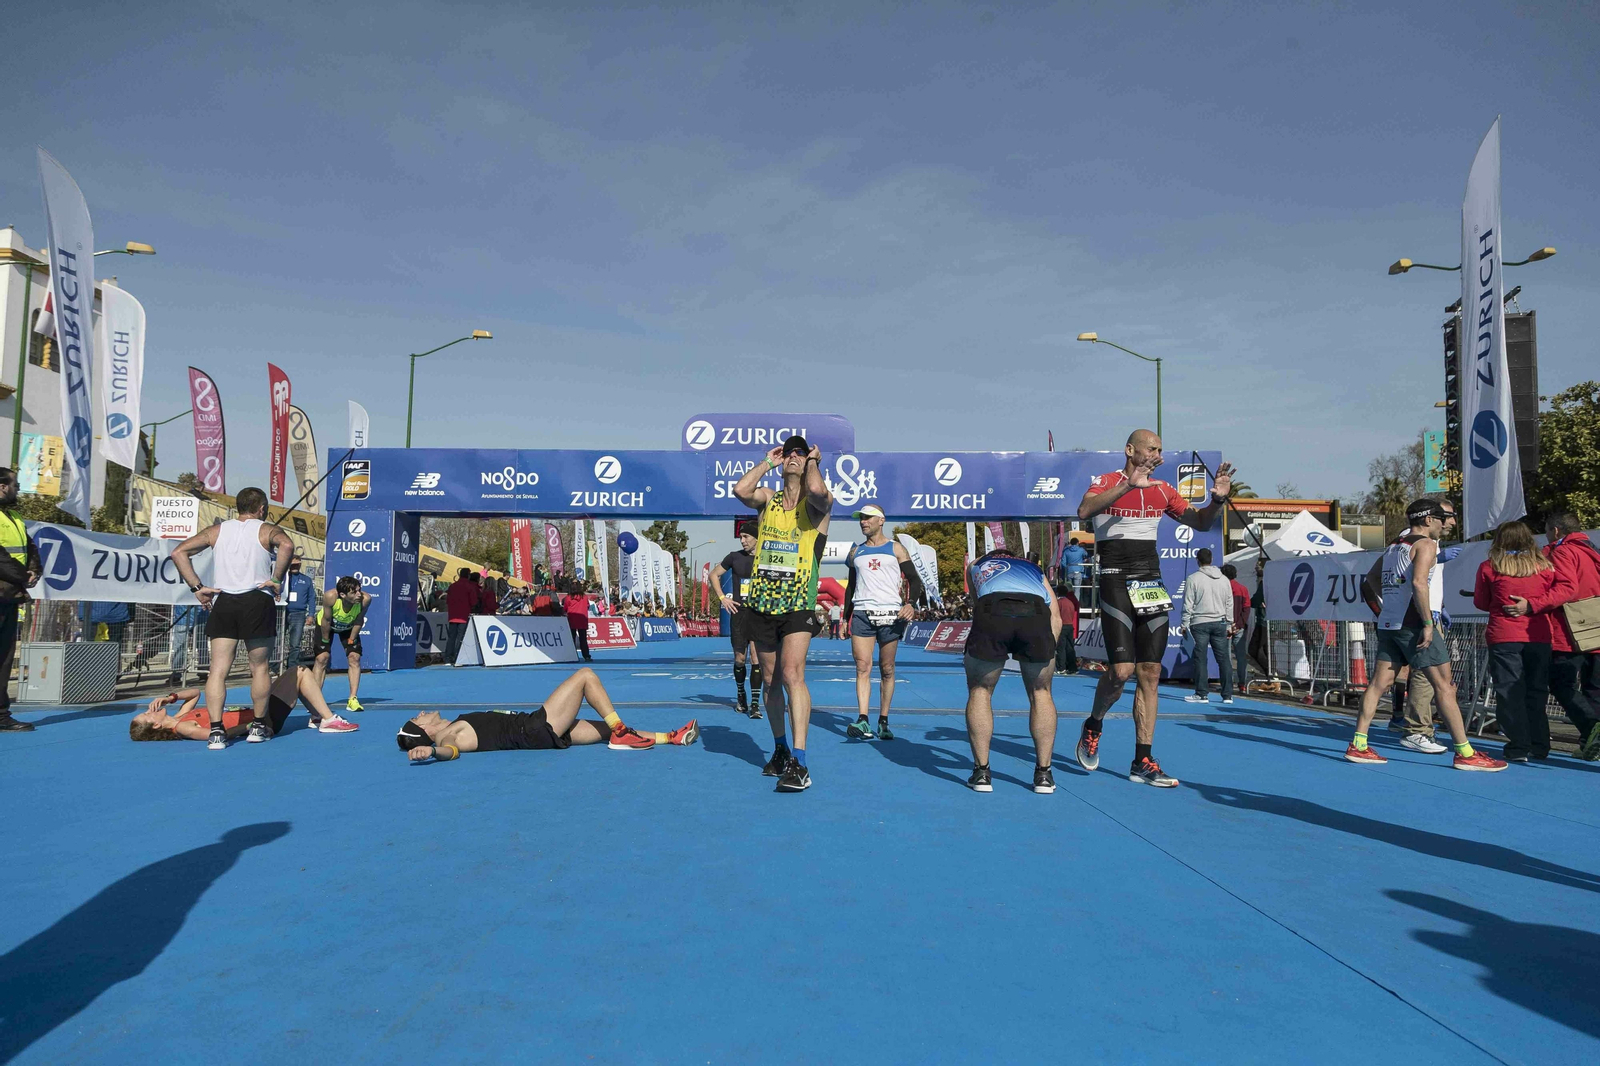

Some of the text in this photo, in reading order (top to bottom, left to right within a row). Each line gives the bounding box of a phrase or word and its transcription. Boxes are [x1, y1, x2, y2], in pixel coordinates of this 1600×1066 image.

[1477, 228, 1495, 391] ZURICH
[570, 491, 644, 507] ZURICH
[911, 494, 986, 509] ZURICH
[156, 509, 194, 518] MÉDICO
[333, 541, 380, 552] ZURICH
[395, 551, 416, 563] ZURICH
[1160, 548, 1199, 559] ZURIC
[91, 549, 186, 585] ZURIC
[652, 625, 673, 634] ZURICH
[511, 632, 563, 648] ZURICH
